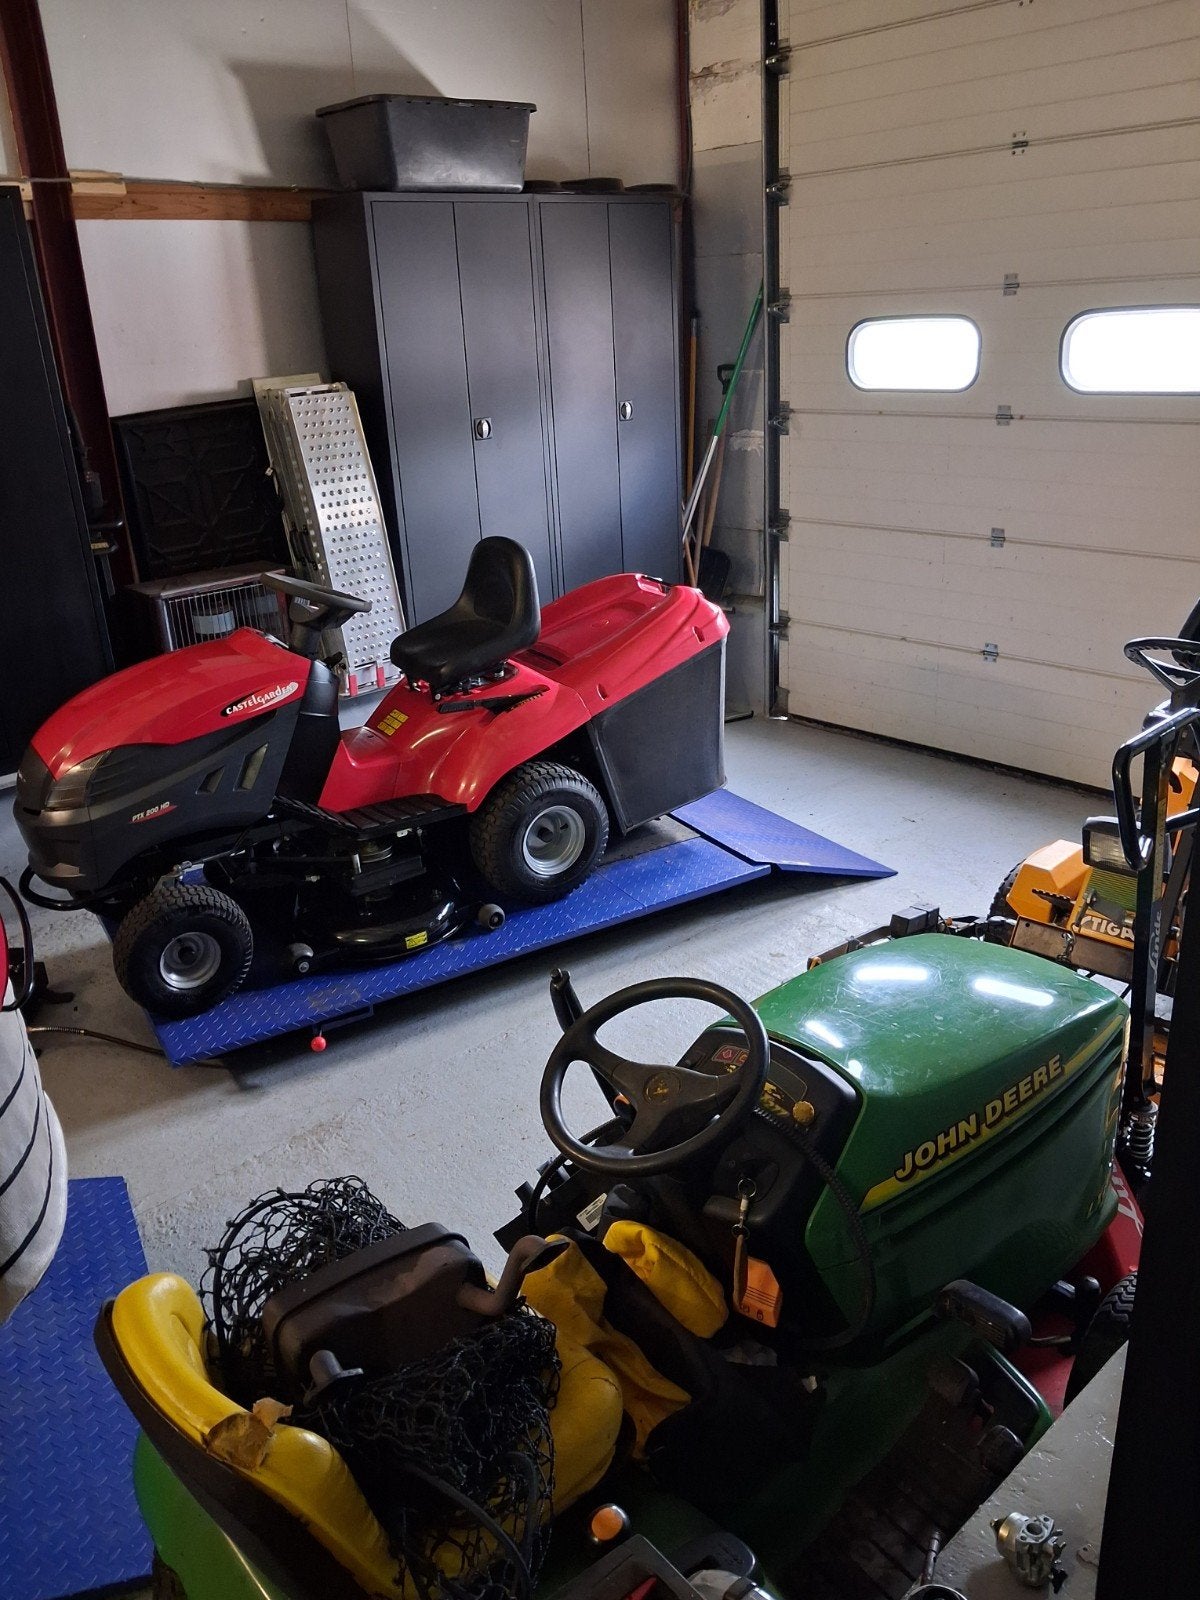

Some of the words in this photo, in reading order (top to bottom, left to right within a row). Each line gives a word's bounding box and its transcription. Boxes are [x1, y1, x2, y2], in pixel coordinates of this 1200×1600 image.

[132, 811, 145, 822] PTX
[145, 806, 159, 816] 200
[160, 801, 170, 811] HD
[1148, 909, 1162, 984] Linde
[895, 1113, 978, 1179] JOHN
[984, 1054, 1062, 1126] DEERE
